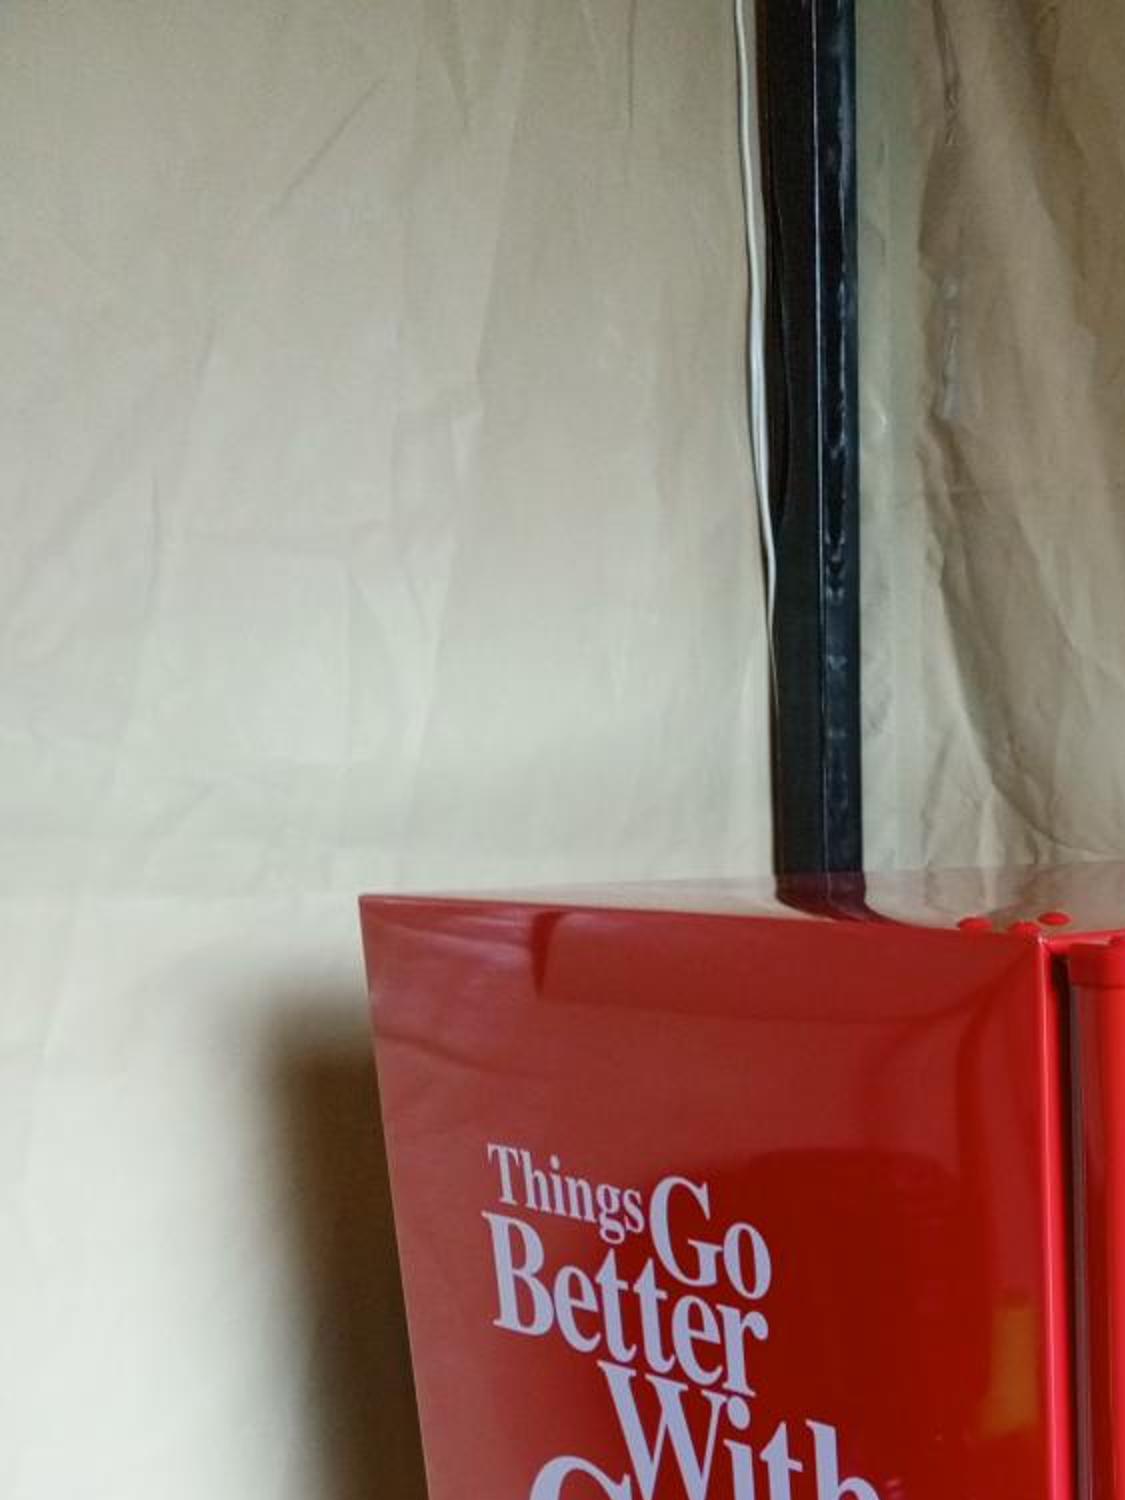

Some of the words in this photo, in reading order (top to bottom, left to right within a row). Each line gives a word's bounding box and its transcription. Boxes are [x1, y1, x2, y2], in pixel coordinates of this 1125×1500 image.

[481, 1210, 769, 1397] Better
[486, 1142, 645, 1244] Things
[649, 1176, 772, 1299] Go
